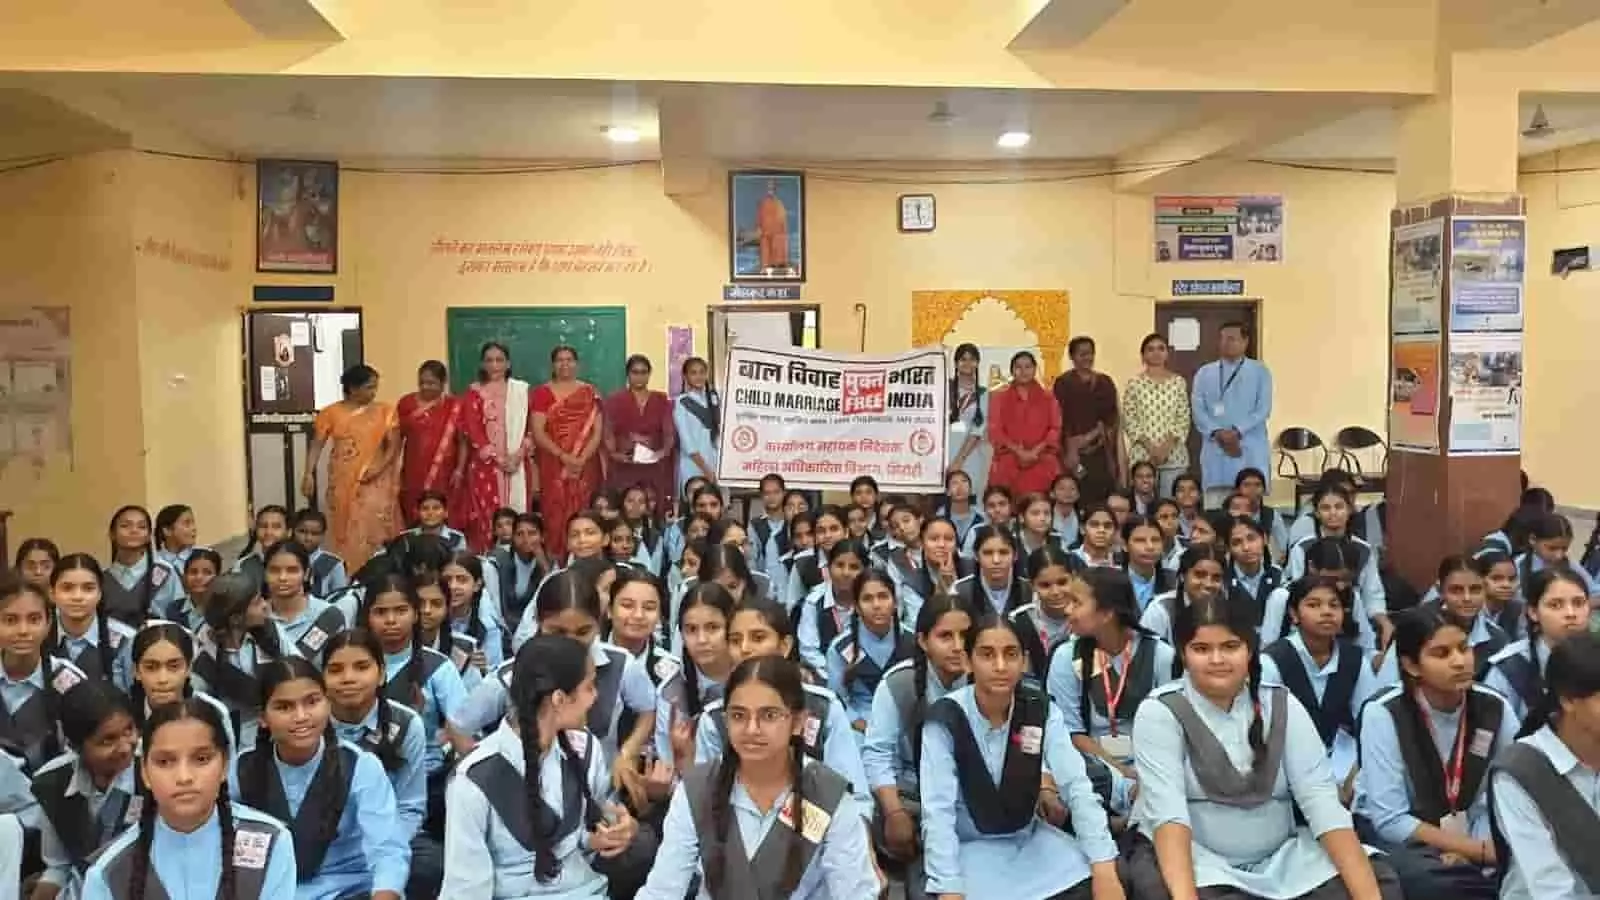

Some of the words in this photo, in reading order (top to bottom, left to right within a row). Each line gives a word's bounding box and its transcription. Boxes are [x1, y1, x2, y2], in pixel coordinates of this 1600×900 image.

[738, 359, 783, 382] बाल
[788, 360, 841, 389] विवाह
[888, 366, 936, 385] भारत
[736, 388, 771, 406] CHILD
[775, 392, 841, 412] MARRIAGE
[848, 396, 883, 408] FREE
[888, 392, 933, 408] INDIA
